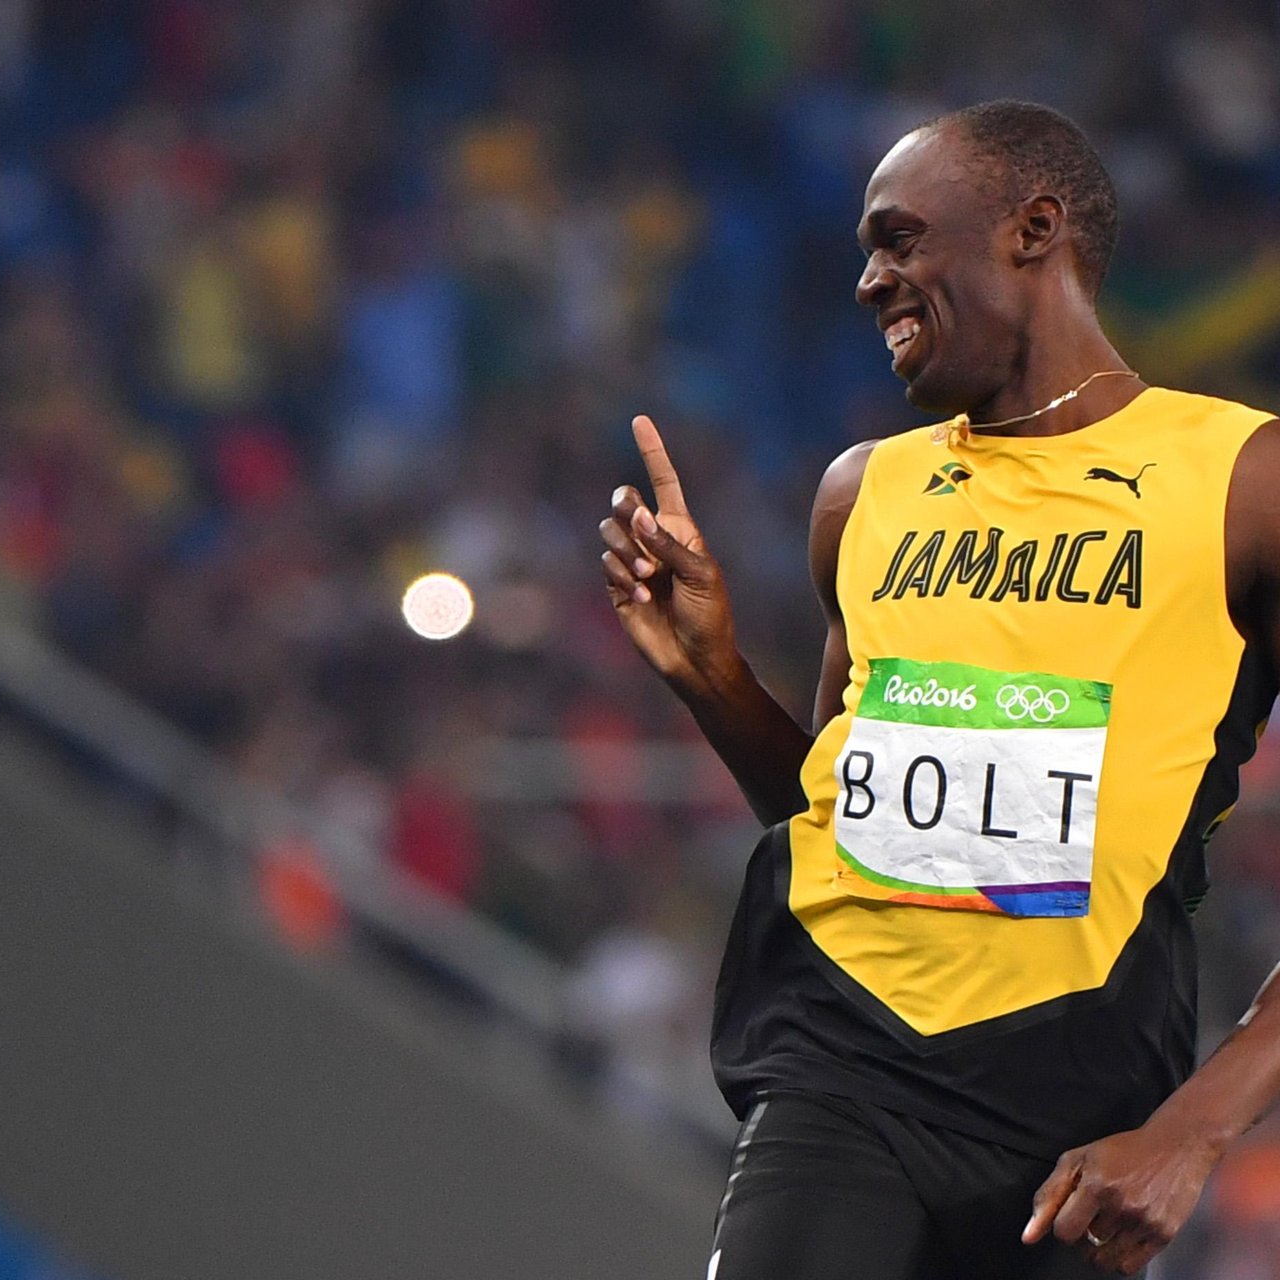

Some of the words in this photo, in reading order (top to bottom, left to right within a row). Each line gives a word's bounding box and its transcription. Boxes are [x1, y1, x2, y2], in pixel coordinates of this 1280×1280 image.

[871, 527, 1144, 609] JAMAICA
[884, 674, 977, 711] Rio2016
[841, 749, 1093, 844] BOLT
